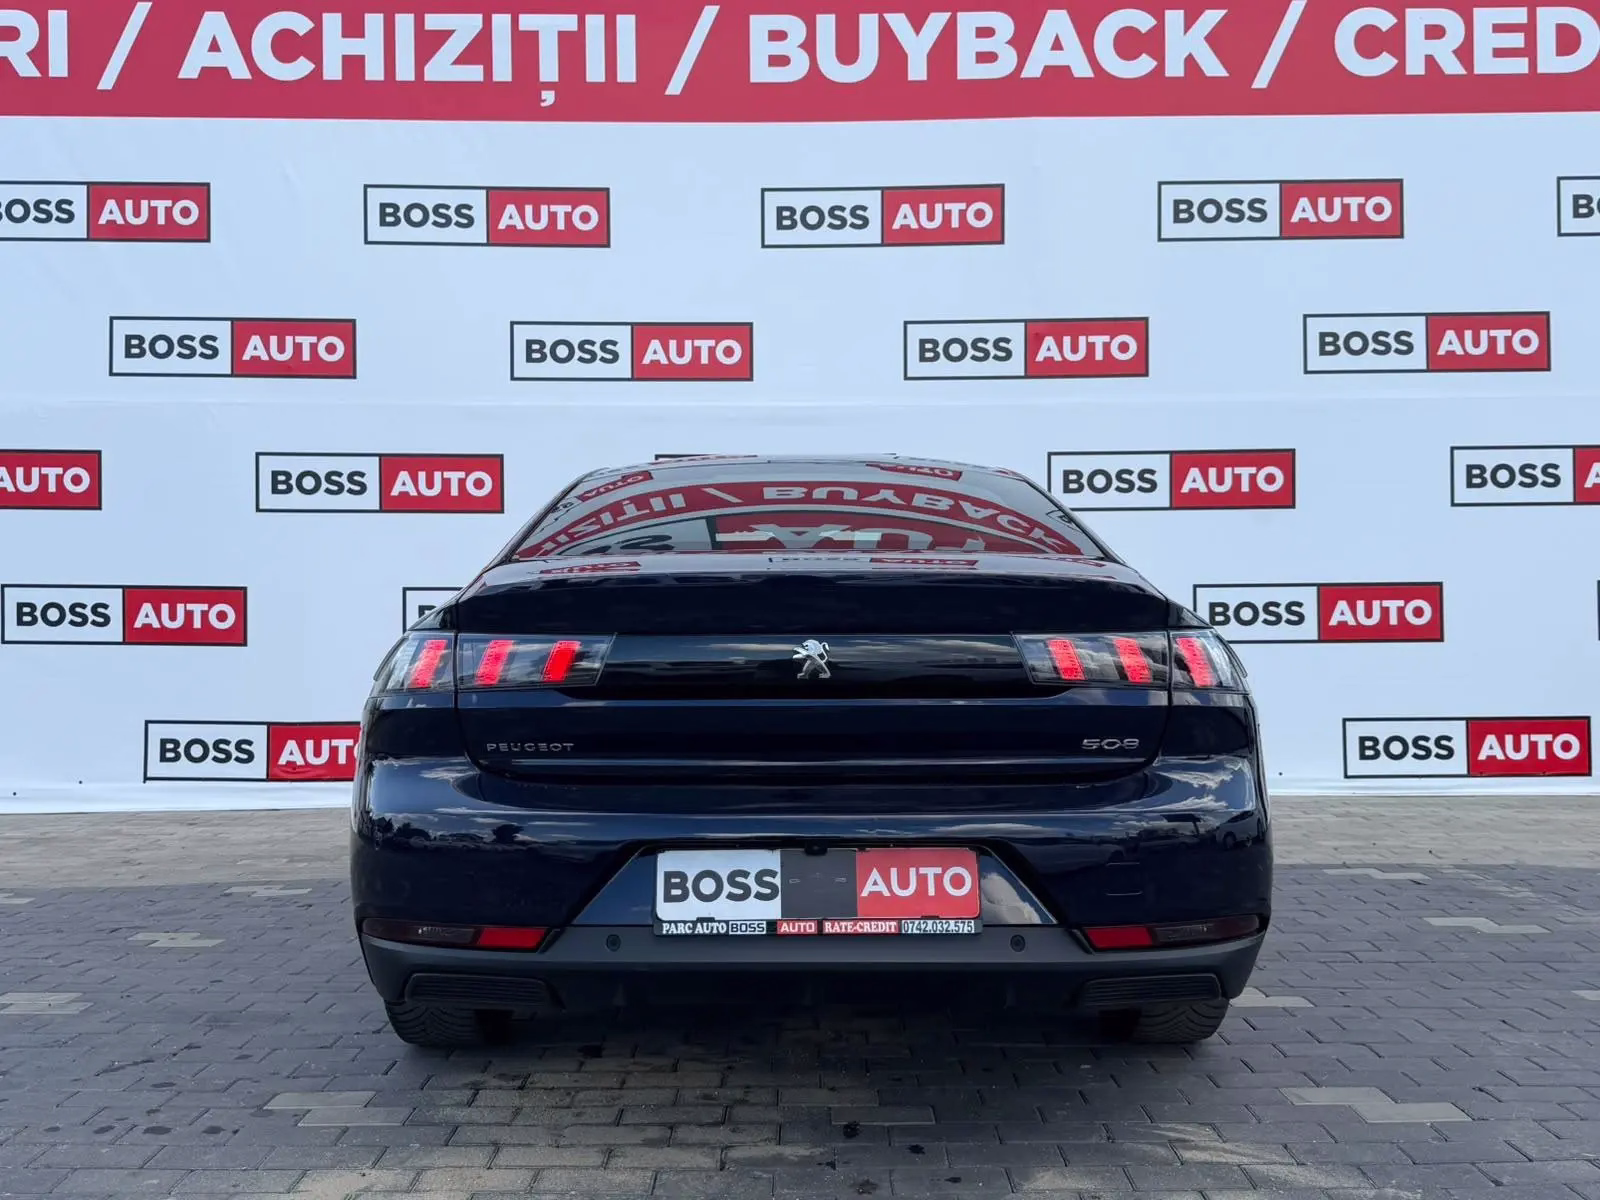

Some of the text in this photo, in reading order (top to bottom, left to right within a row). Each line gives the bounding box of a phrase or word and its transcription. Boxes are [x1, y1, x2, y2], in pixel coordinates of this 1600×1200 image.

[178, 11, 636, 106] ACHIZIȚII
[750, 9, 1229, 83] BUYBACK
[1335, 7, 1600, 76] CRED
[0, 199, 198, 225] OSS AUTO
[380, 203, 598, 230] BOSS AUTO
[777, 202, 993, 230] BOSS AUTO
[1173, 196, 1392, 223] BOSS AUTO
[1573, 195, 1600, 218] B
[125, 335, 344, 361] BOSS AUTO
[526, 339, 742, 364] BOSS AUTO
[919, 335, 1137, 362] BOSS AUTO
[1319, 329, 1539, 356] BOSS AUTO
[272, 471, 492, 496] BOSS AUTO
[1063, 467, 1283, 493] BOSS AUTO
[1466, 463, 1561, 488] BOSS
[17, 602, 235, 629] BOSS AUTO
[1208, 600, 1431, 626] BOSS AUTO
[160, 738, 360, 765] BOSS AUT
[486, 743, 575, 752] PEUGEOT
[1081, 738, 1140, 750] 508
[1359, 734, 1579, 760] BOSS AUTO
[664, 867, 971, 902] BOSS AUTO
[662, 920, 973, 934] PARC AUTO BOSS AUTO RATE-CREDIT 0742.032.575
